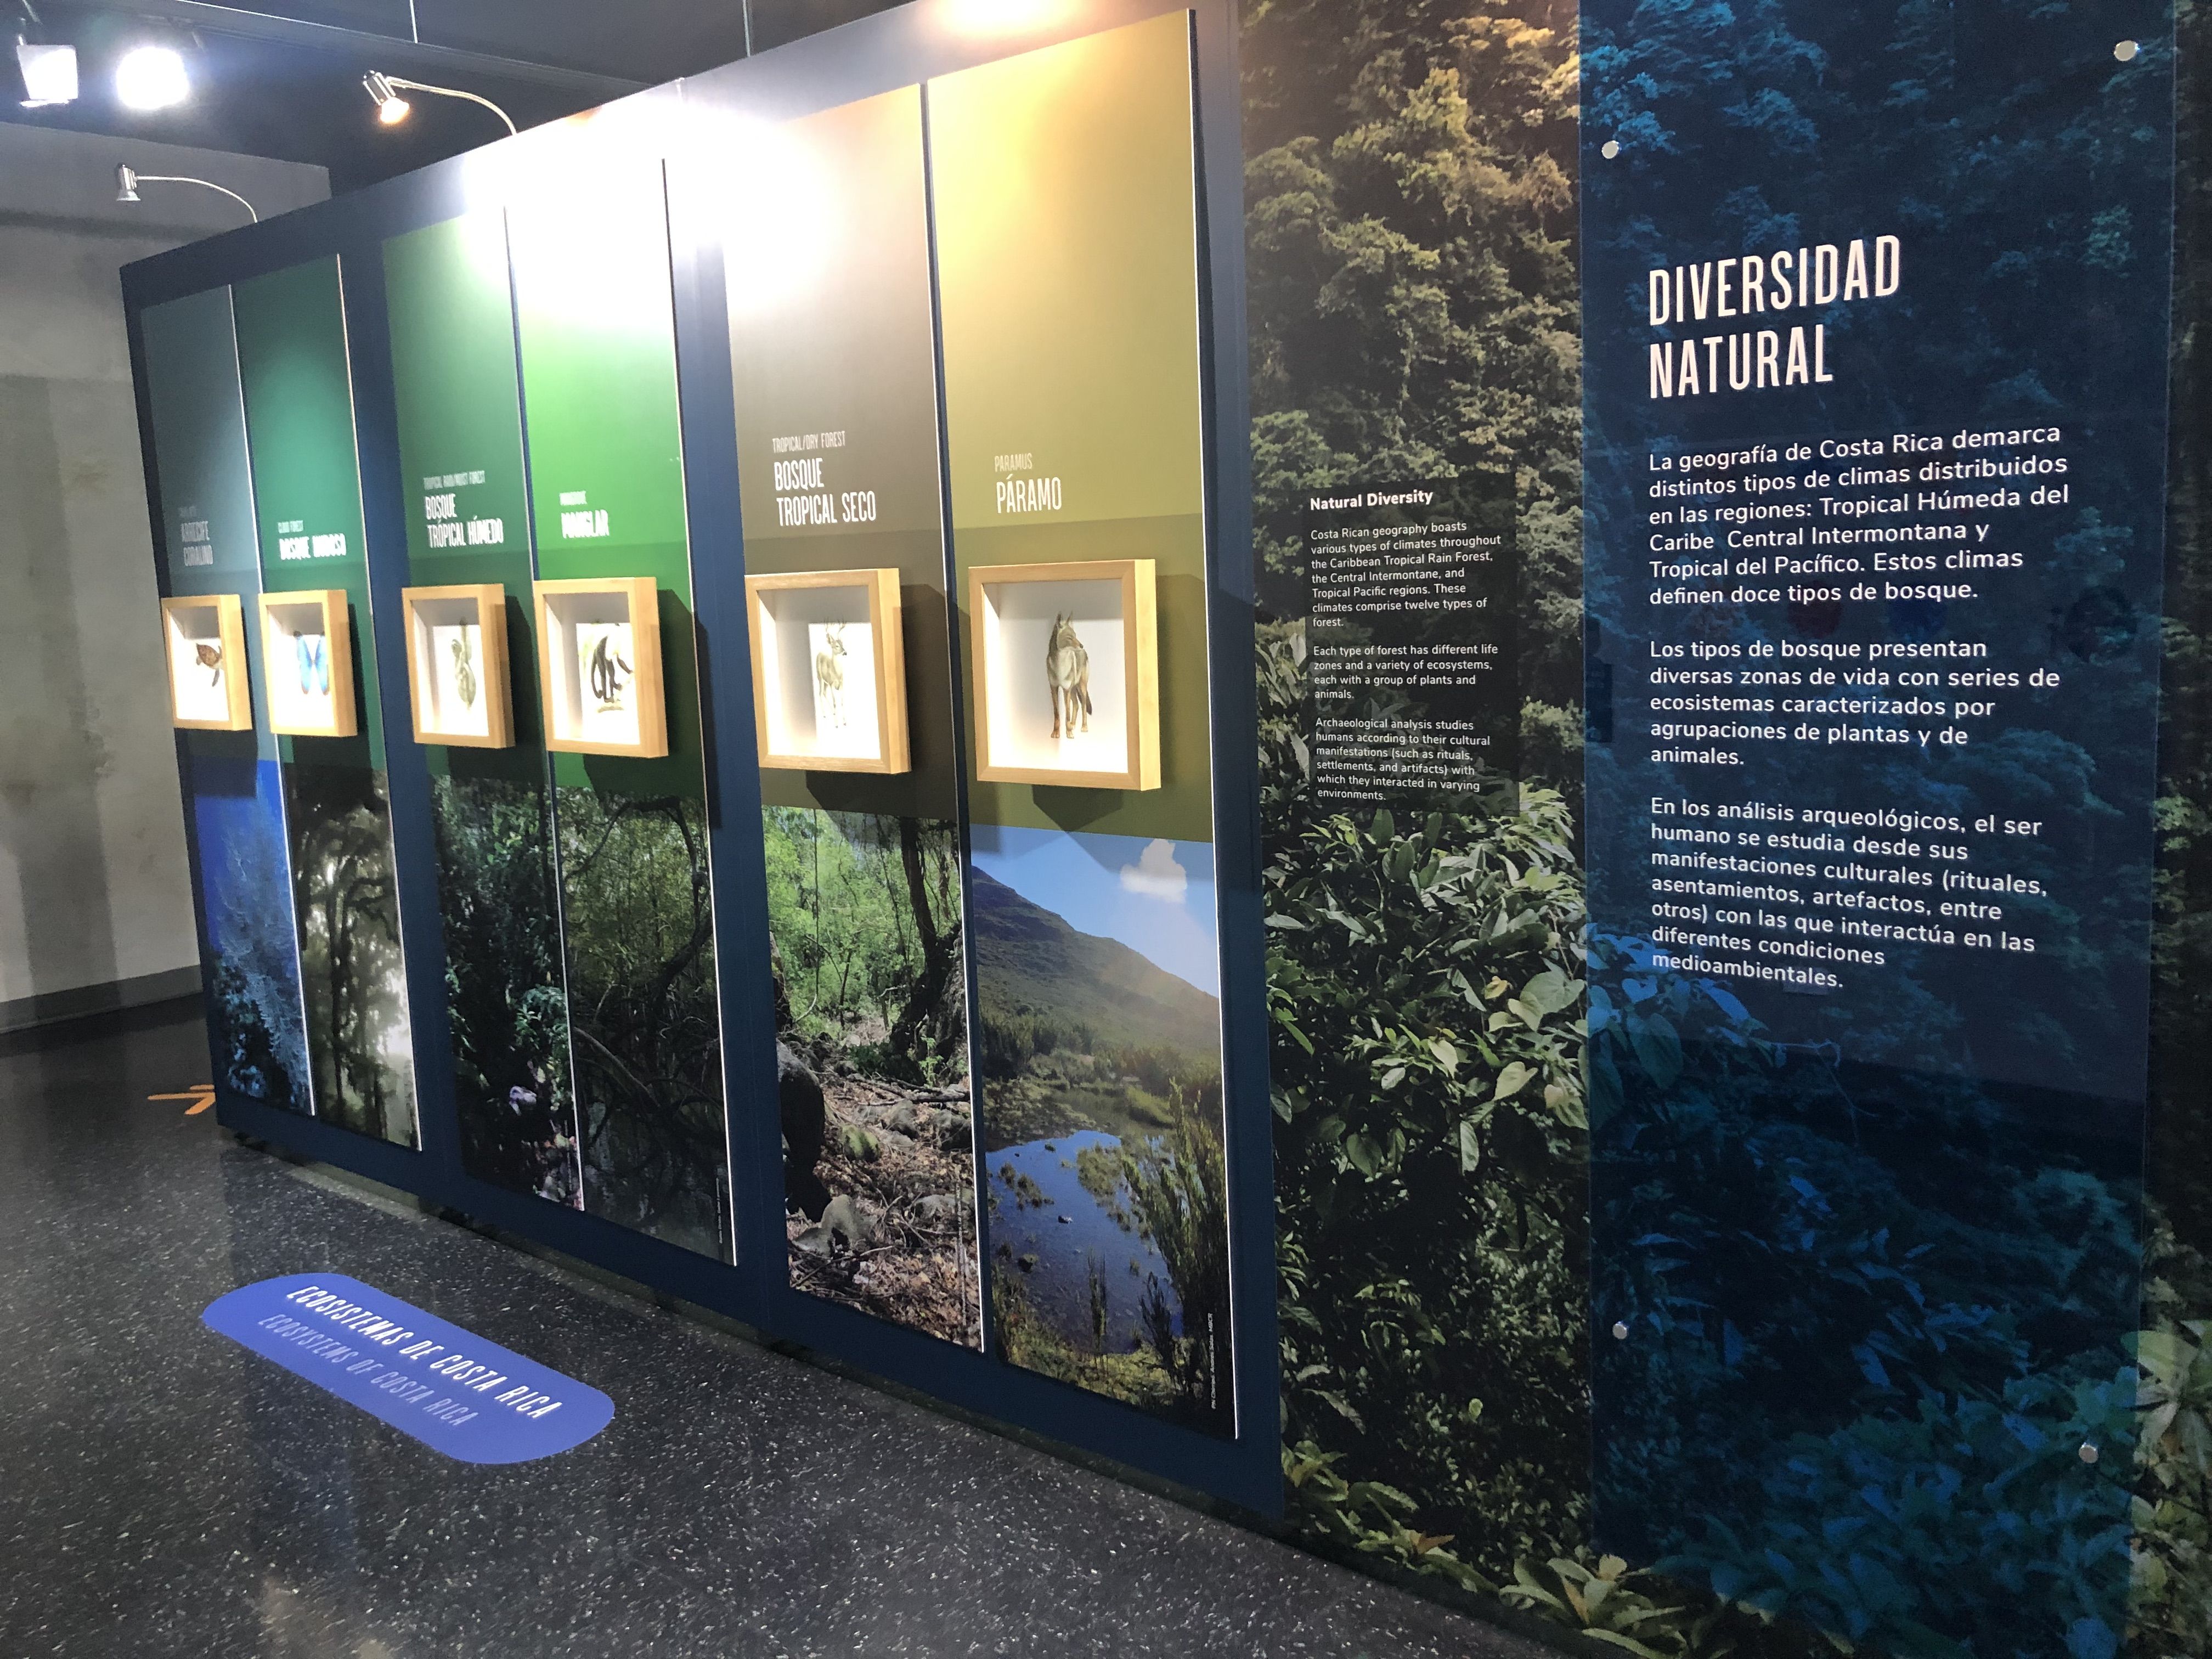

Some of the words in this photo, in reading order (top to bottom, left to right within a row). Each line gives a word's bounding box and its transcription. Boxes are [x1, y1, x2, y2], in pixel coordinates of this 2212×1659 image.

[1649, 234, 1900, 326] DIVERSIDAD
[1650, 324, 1833, 399] NATURAL
[772, 434, 819, 454] TROPICAL/DRY
[821, 430, 846, 449] FOREST
[1650, 453, 1672, 471] La
[1679, 443, 1777, 473] geografía
[1785, 442, 1812, 461] de
[1820, 438, 1883, 459] Costa
[1893, 433, 1943, 454] Rica
[1952, 427, 2060, 449] demarca
[774, 458, 825, 491] BOSQUE
[994, 452, 1033, 472] PARAMUS
[1649, 478, 1736, 498] distintos
[1743, 474, 1796, 495] tipos
[1804, 469, 1830, 488] de
[1838, 466, 1910, 486] climas
[1919, 454, 2067, 481] distribuidos
[425, 493, 458, 520] BOSQUE
[996, 473, 1062, 514] PÁRAMO
[1310, 494, 1362, 511] Natural
[1367, 490, 1434, 507] Diversity
[1649, 511, 1673, 524] en
[1680, 506, 1708, 523] las
[1716, 501, 1812, 524] regiones:
[1819, 493, 1908, 518] Tropical
[1918, 487, 2020, 511] Húmeda
[2030, 483, 2068, 505] del
[776, 493, 838, 526] TROPICAL
[841, 490, 877, 523] SECO
[467, 515, 504, 546] HÚMEDO
[1311, 529, 1339, 540] Costa
[1341, 527, 1369, 538] Rican
[1372, 523, 1428, 539] geography
[1431, 521, 1467, 533] boasts
[1650, 532, 1714, 552] Caribe
[1728, 527, 1803, 548] Central
[1812, 523, 1966, 545] Intermontana
[1975, 523, 1989, 543] y
[1311, 543, 1346, 555] various
[1349, 543, 1377, 555] types
[1380, 539, 1391, 551] of
[1393, 539, 1437, 550] climates
[1440, 534, 1501, 549] throughout
[1311, 558, 1327, 569] the
[1330, 557, 1381, 569] Caribbean
[1384, 553, 1425, 567] Tropical
[1428, 552, 1452, 564] Rain
[1455, 551, 1493, 562] Forest,
[1649, 558, 1728, 582] Tropical
[1736, 556, 1767, 575] del
[1775, 553, 1865, 574] Pacífico.
[1874, 552, 1937, 571] Estos
[1945, 549, 2023, 569] climas
[1311, 573, 1328, 584] the
[1330, 572, 1366, 583] Central
[1369, 570, 1441, 582] Intermontane,
[1444, 567, 1465, 578] and
[1312, 587, 1350, 600] Tropical
[1353, 585, 1386, 597] Pacific
[1389, 584, 1430, 597] regions.
[1434, 583, 1466, 594] These
[1312, 602, 1353, 613] climates
[1355, 600, 1402, 613] comprise
[1404, 599, 1440, 610] twelve
[1442, 599, 1472, 611] types
[1476, 596, 1488, 608] of
[1650, 586, 1723, 605] definen
[1731, 585, 1780, 603] doce
[1787, 584, 1841, 606] tipos
[1849, 582, 1877, 601] de
[1885, 582, 1978, 603] bosque.
[1312, 617, 1344, 627] forest.
[1313, 645, 1336, 656] Each
[1339, 646, 1362, 658] type
[1364, 645, 1375, 656] of
[1376, 645, 1407, 655] forest
[1410, 645, 1429, 655] has
[1431, 644, 1478, 654] different
[1481, 643, 1498, 654] life
[1651, 640, 1684, 657] Los
[1690, 640, 1741, 661] tipos
[1748, 639, 1774, 657] de
[1781, 639, 1861, 661] bosque
[1869, 640, 1987, 661] presentan
[1314, 689, 1354, 699] animals.
[1650, 693, 1774, 712] ecosistemas
[1782, 696, 1945, 715] caracterizados
[1955, 701, 1996, 719] por
[1316, 717, 1387, 730] Archaeological
[1391, 719, 1432, 731] analysis
[1435, 720, 1474, 730] studies
[1651, 720, 1786, 741] agrupaciones
[1794, 722, 1820, 741] de
[1828, 723, 1910, 744] plantas
[1918, 730, 1931, 747] y
[1939, 725, 1968, 745] de
[1316, 731, 1353, 742] humans
[1357, 733, 1407, 746] according
[1408, 735, 1419, 744] to
[1422, 734, 1447, 744] their
[1449, 735, 1490, 746] cultural
[1316, 746, 1388, 758] manifestations
[1391, 747, 1419, 760] (such
[1421, 751, 1434, 759] as
[1437, 749, 1473, 761] rituals,
[1651, 746, 1744, 765] animales.
[1317, 760, 1376, 772] settlements,
[1379, 762, 1398, 772] and
[1401, 763, 1449, 776] artifacts)
[1451, 764, 1475, 776] with
[1317, 774, 1346, 785] which
[1348, 775, 1370, 787] they
[1373, 775, 1424, 788] interacted
[1427, 778, 1437, 789] in
[1440, 780, 1480, 793] varying
[1317, 788, 1386, 801] environments.
[1651, 797, 1675, 815] En
[1682, 798, 1710, 817] los
[1717, 800, 1794, 821] análisis
[1802, 808, 1966, 833] arqueológicos,
[1974, 814, 1995, 833] el
[2004, 820, 2042, 836] ser
[1651, 822, 1730, 844] humano
[1737, 832, 1760, 847] se
[1767, 832, 1844, 852] estudia
[1853, 836, 1921, 857] desde
[1929, 844, 1968, 861] sus
[1651, 851, 1816, 877] manifestaciones
[1824, 862, 1933, 886] culturales
[1943, 868, 2046, 898] (rituales,
[1652, 878, 1804, 905] asentamientos,
[1813, 890, 1931, 916] artefactos,
[1940, 901, 2002, 920] entre
[1652, 925, 1751, 951] diferentes
[1758, 940, 1885, 965] condiciones
[1652, 954, 1843, 988] medioambientales.
[286, 1285, 414, 1345] ECOSISTEMAS
[398, 1340, 445, 1361] DE
[430, 1354, 508, 1392] COSTA
[494, 1385, 563, 1419] RICA
[258, 1314, 359, 1363] ECOSYSTEMS
[346, 1359, 384, 1375] OF
[370, 1371, 435, 1404] COSTA
[423, 1397, 479, 1426] RICA
